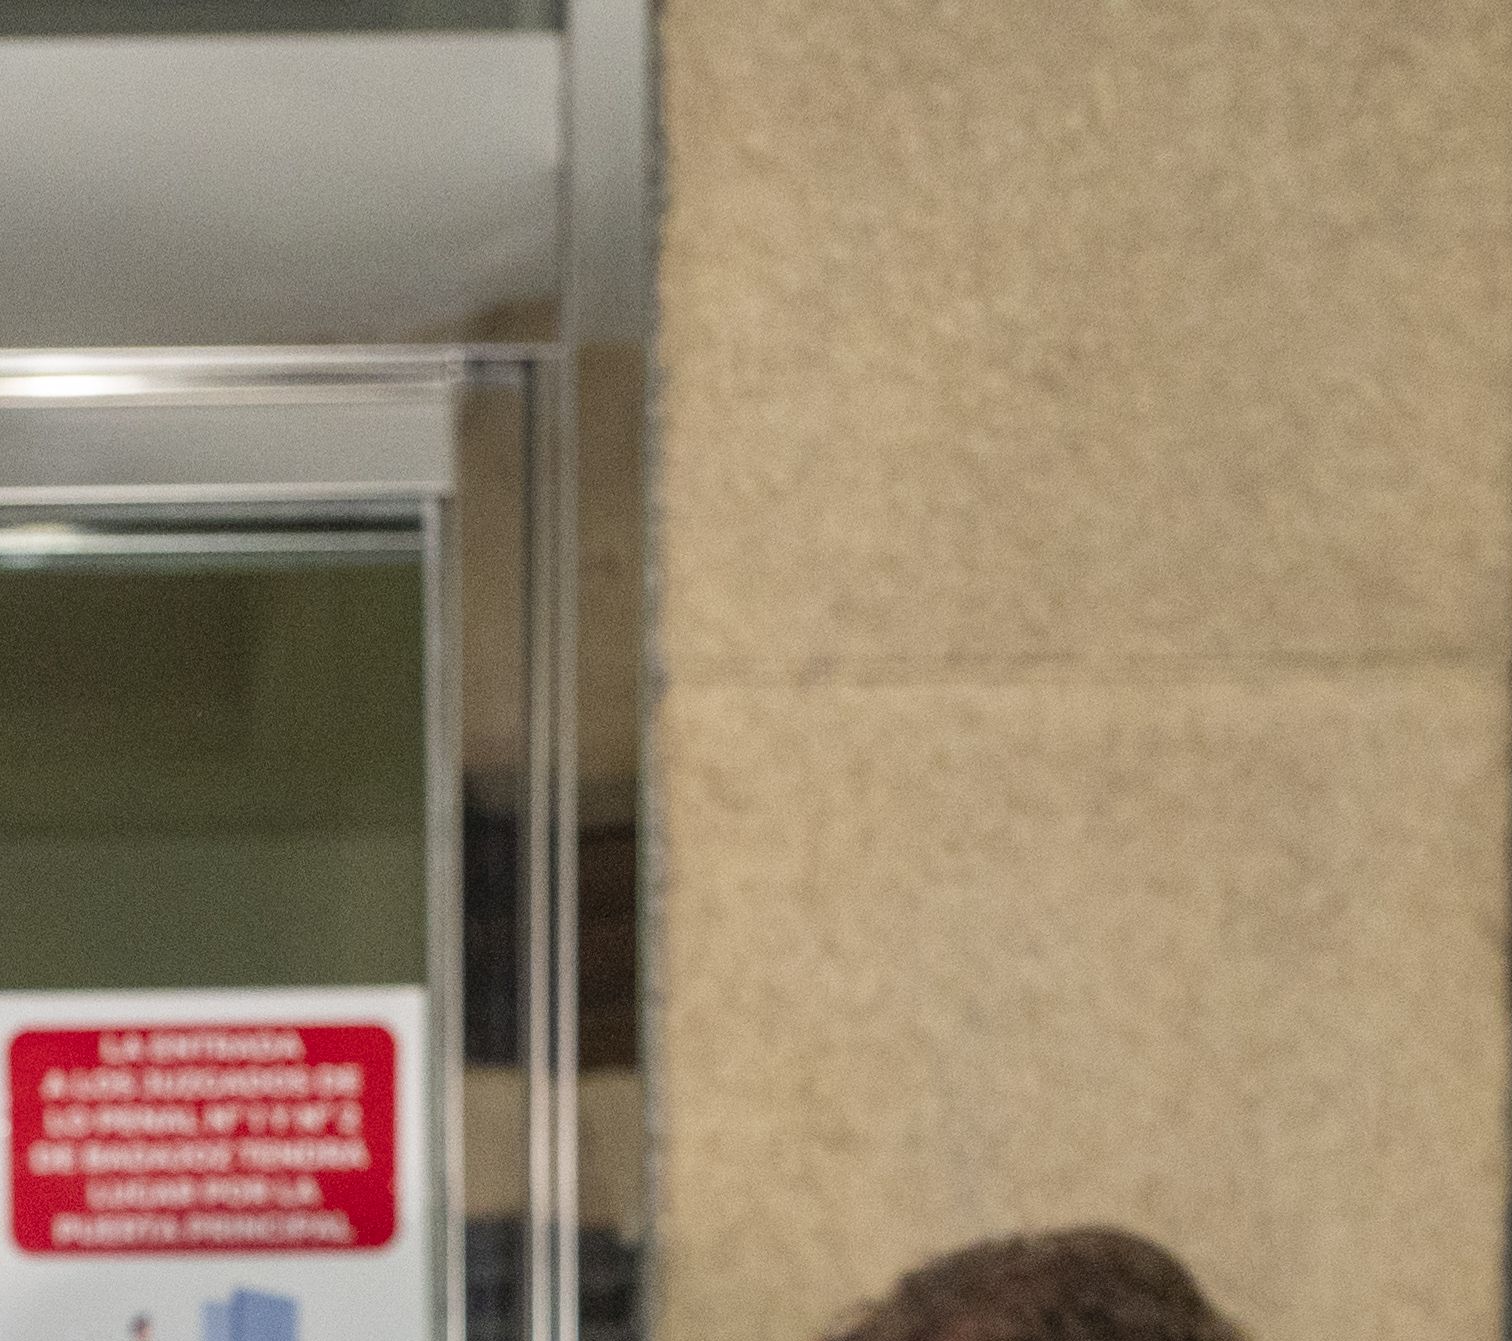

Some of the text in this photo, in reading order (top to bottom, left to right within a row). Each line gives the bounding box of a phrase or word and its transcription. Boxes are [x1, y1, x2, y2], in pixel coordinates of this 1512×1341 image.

[147, 1031, 304, 1062] ENTRADA
[315, 1064, 365, 1096] DE
[30, 1143, 81, 1174] DE
[200, 1176, 272, 1207] POR
